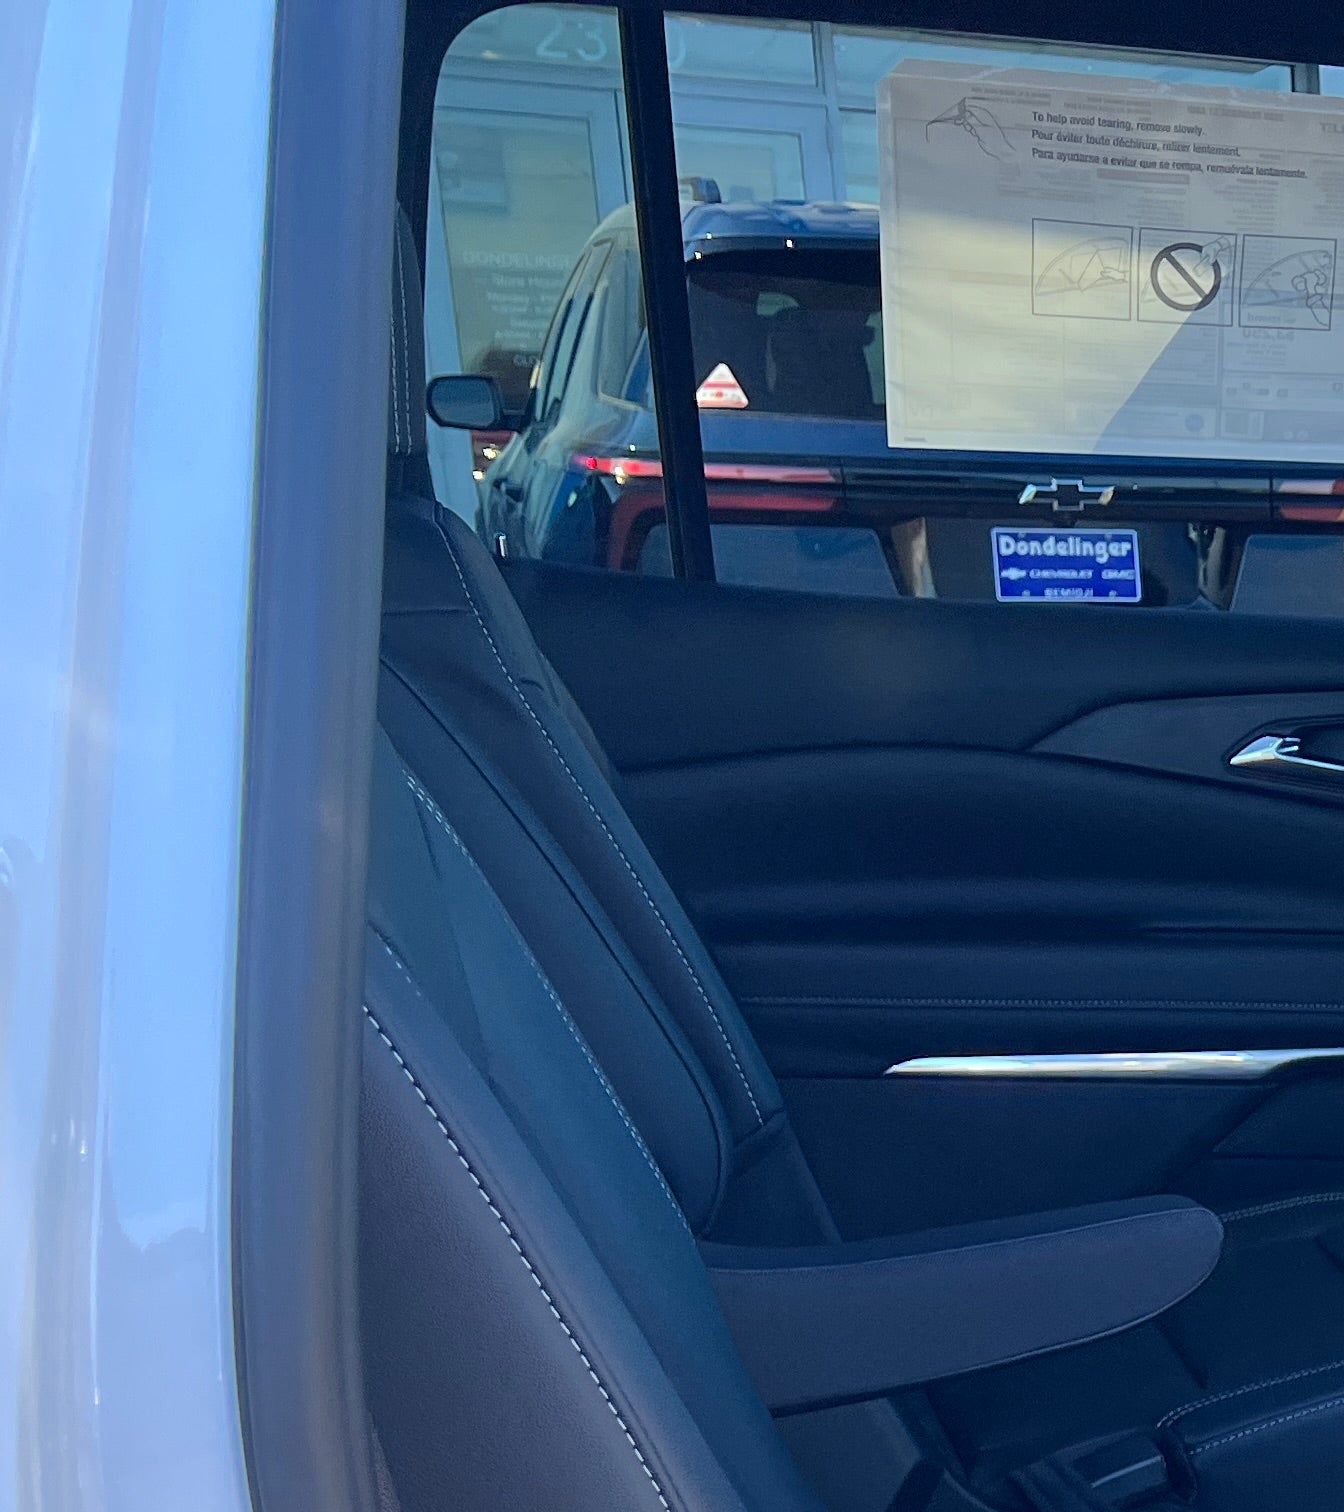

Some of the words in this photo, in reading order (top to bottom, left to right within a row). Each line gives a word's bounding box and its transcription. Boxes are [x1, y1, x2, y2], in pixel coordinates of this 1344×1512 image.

[1032, 111, 1044, 122] To
[1046, 112, 1067, 125] help
[1070, 115, 1095, 126] avoid
[1098, 118, 1134, 132] tearing,
[1136, 122, 1171, 133] remove
[1173, 124, 1206, 137] slowly.
[1032, 129, 1053, 141] Pour
[1086, 134, 1110, 146] toute
[1032, 147, 1054, 160] Para
[1056, 151, 1100, 164] ayudarse
[1102, 156, 1109, 164] a
[1110, 156, 1137, 168] evitar
[1139, 160, 1157, 170] que
[1159, 161, 1170, 169] se
[999, 534, 1132, 564] Dondelinger
